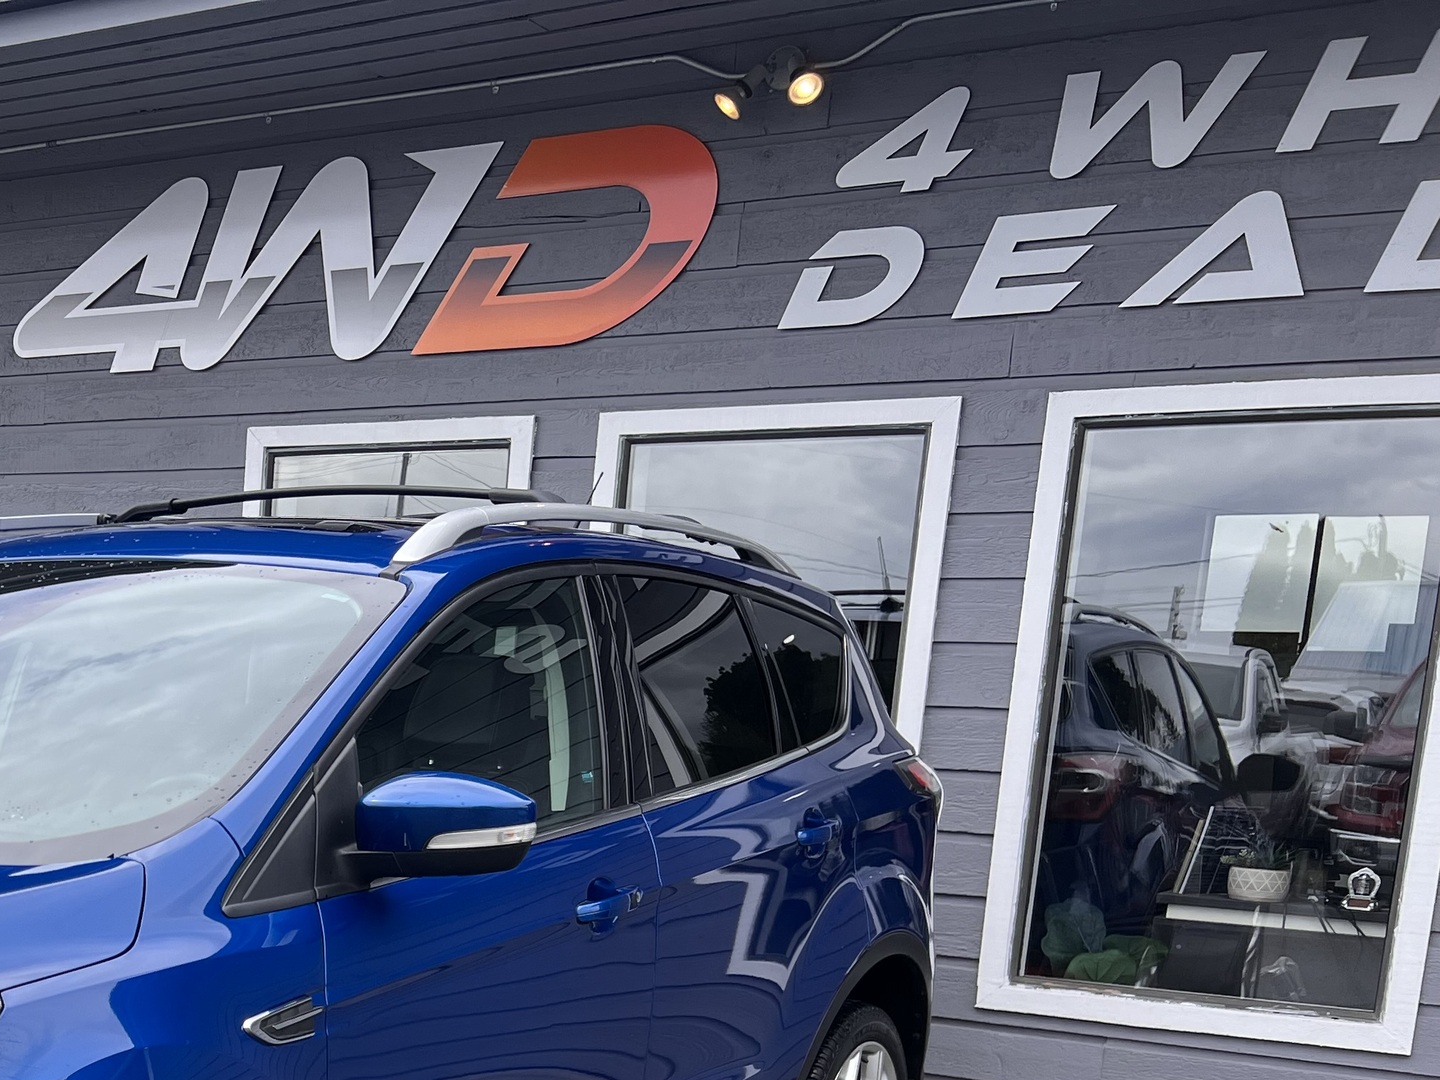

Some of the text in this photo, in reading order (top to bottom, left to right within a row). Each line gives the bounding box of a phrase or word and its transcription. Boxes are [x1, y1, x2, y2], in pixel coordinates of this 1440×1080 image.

[836, 27, 1440, 192] 4 WH
[13, 124, 718, 373] 4WD
